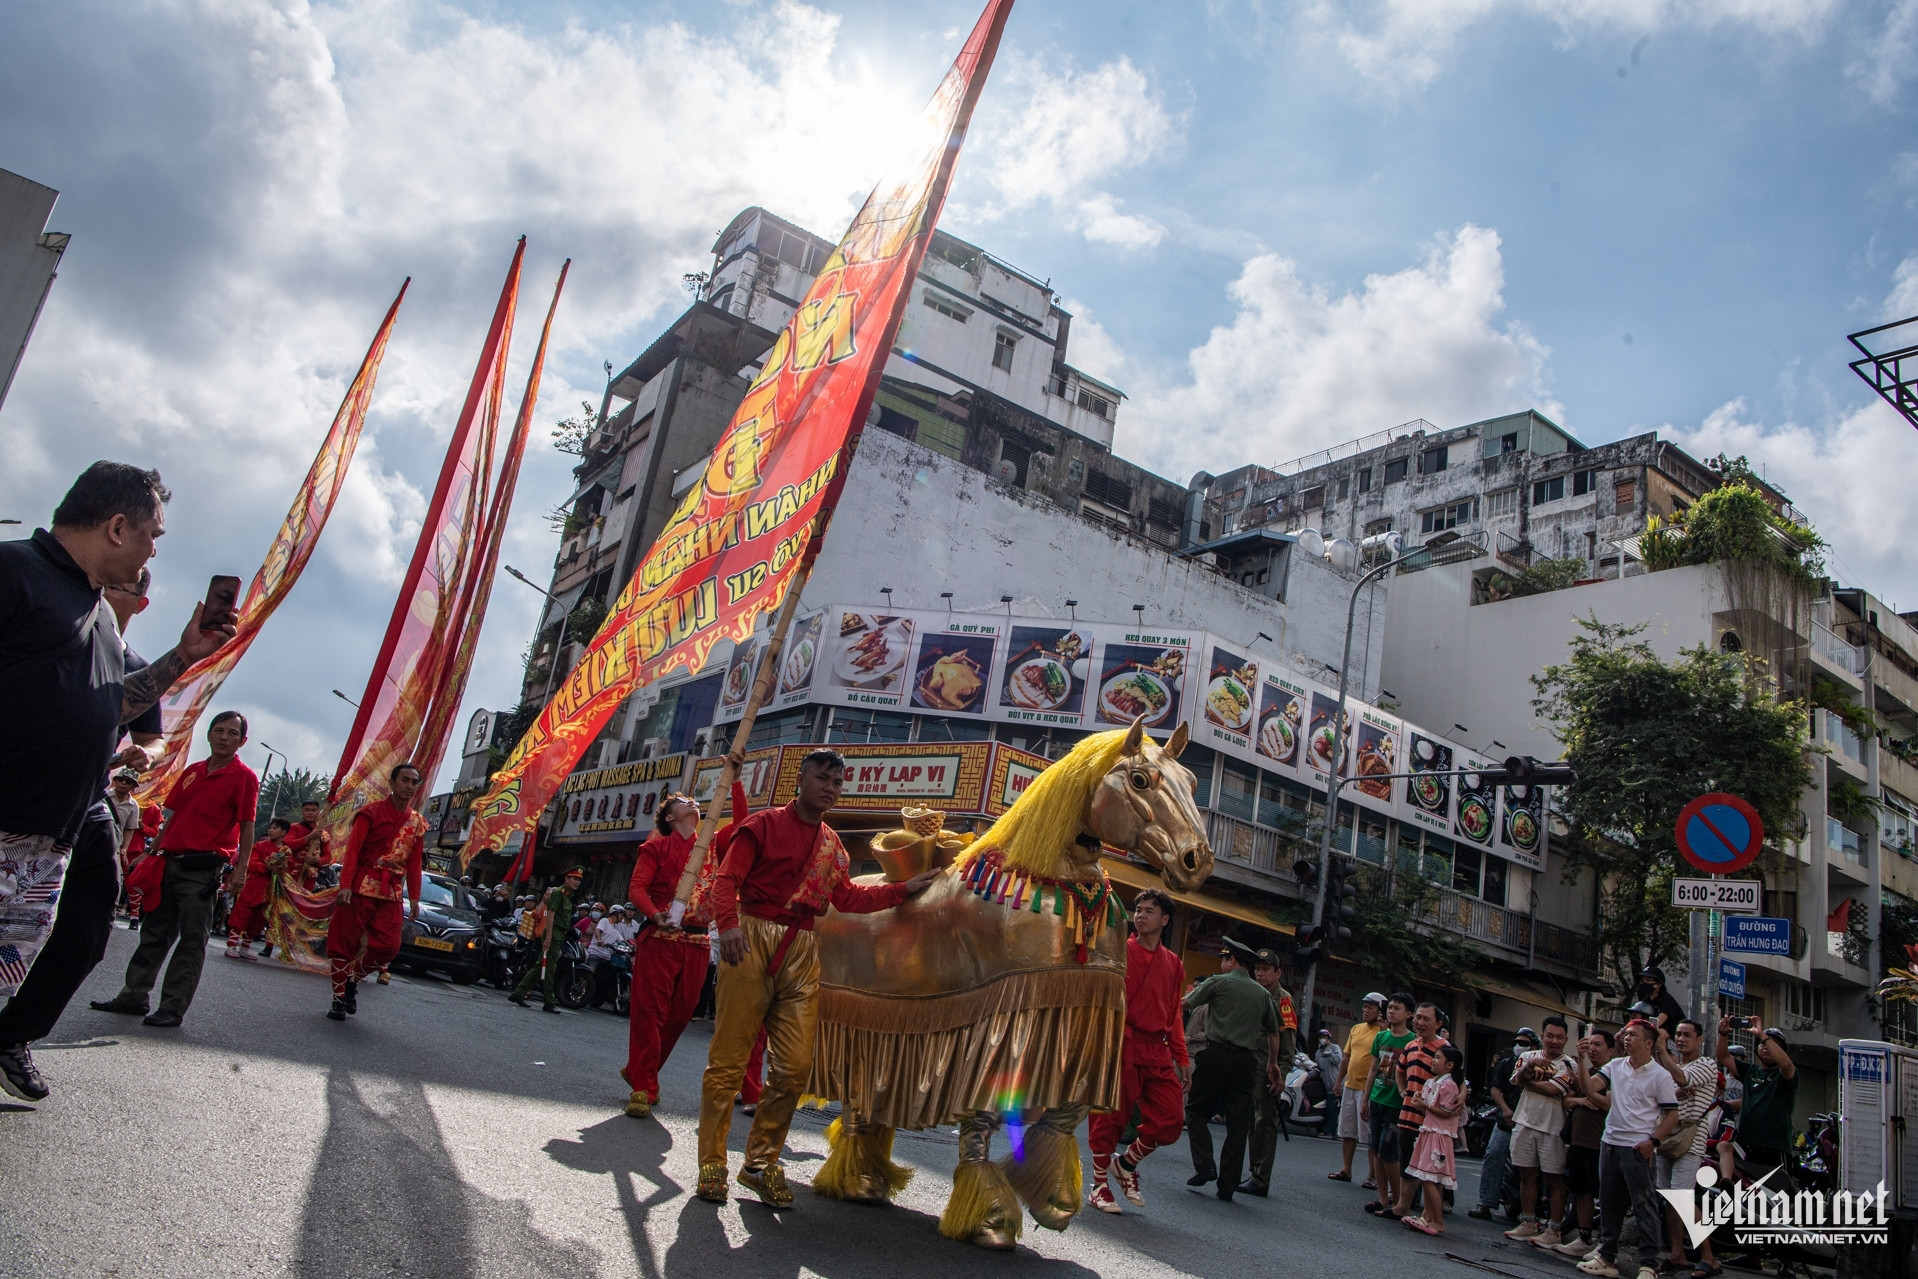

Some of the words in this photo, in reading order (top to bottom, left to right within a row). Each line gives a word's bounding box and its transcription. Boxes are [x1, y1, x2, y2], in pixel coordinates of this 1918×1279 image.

[949, 623, 961, 633] GÀ
[962, 623, 980, 633] QUÝ
[980, 625, 995, 634] PHI
[1125, 634, 1140, 642] HEO
[1142, 635, 1161, 644] QUAY
[1162, 637, 1168, 645] 3
[1169, 636, 1187, 646] MÓN
[1279, 679, 1292, 690] QUAY
[878, 696, 899, 706] QUAY
[732, 707, 742, 715] QUAY
[1022, 712, 1035, 722] VỊT
[1043, 714, 1058, 722] HEO
[1059, 716, 1079, 725] QUAY
[1224, 732, 1231, 742] GÀ
[586, 770, 602, 792] FOOT
[600, 765, 633, 788] MASSAGE
[631, 762, 647, 783] SPA
[646, 761, 655, 781] &
[655, 755, 684, 780] SAUNA
[858, 762, 885, 782] KÝ
[888, 766, 922, 787] LẠP
[927, 766, 946, 788] VỊ
[1012, 773, 1035, 793] HƯ
[1739, 920, 1776, 933] ĐƯỜNG
[1726, 933, 1747, 949] TRẦN
[1748, 937, 1770, 950] HƯNG
[1771, 937, 1788, 953] ĐẠO
[1723, 964, 1741, 977] ĐƯỜNG
